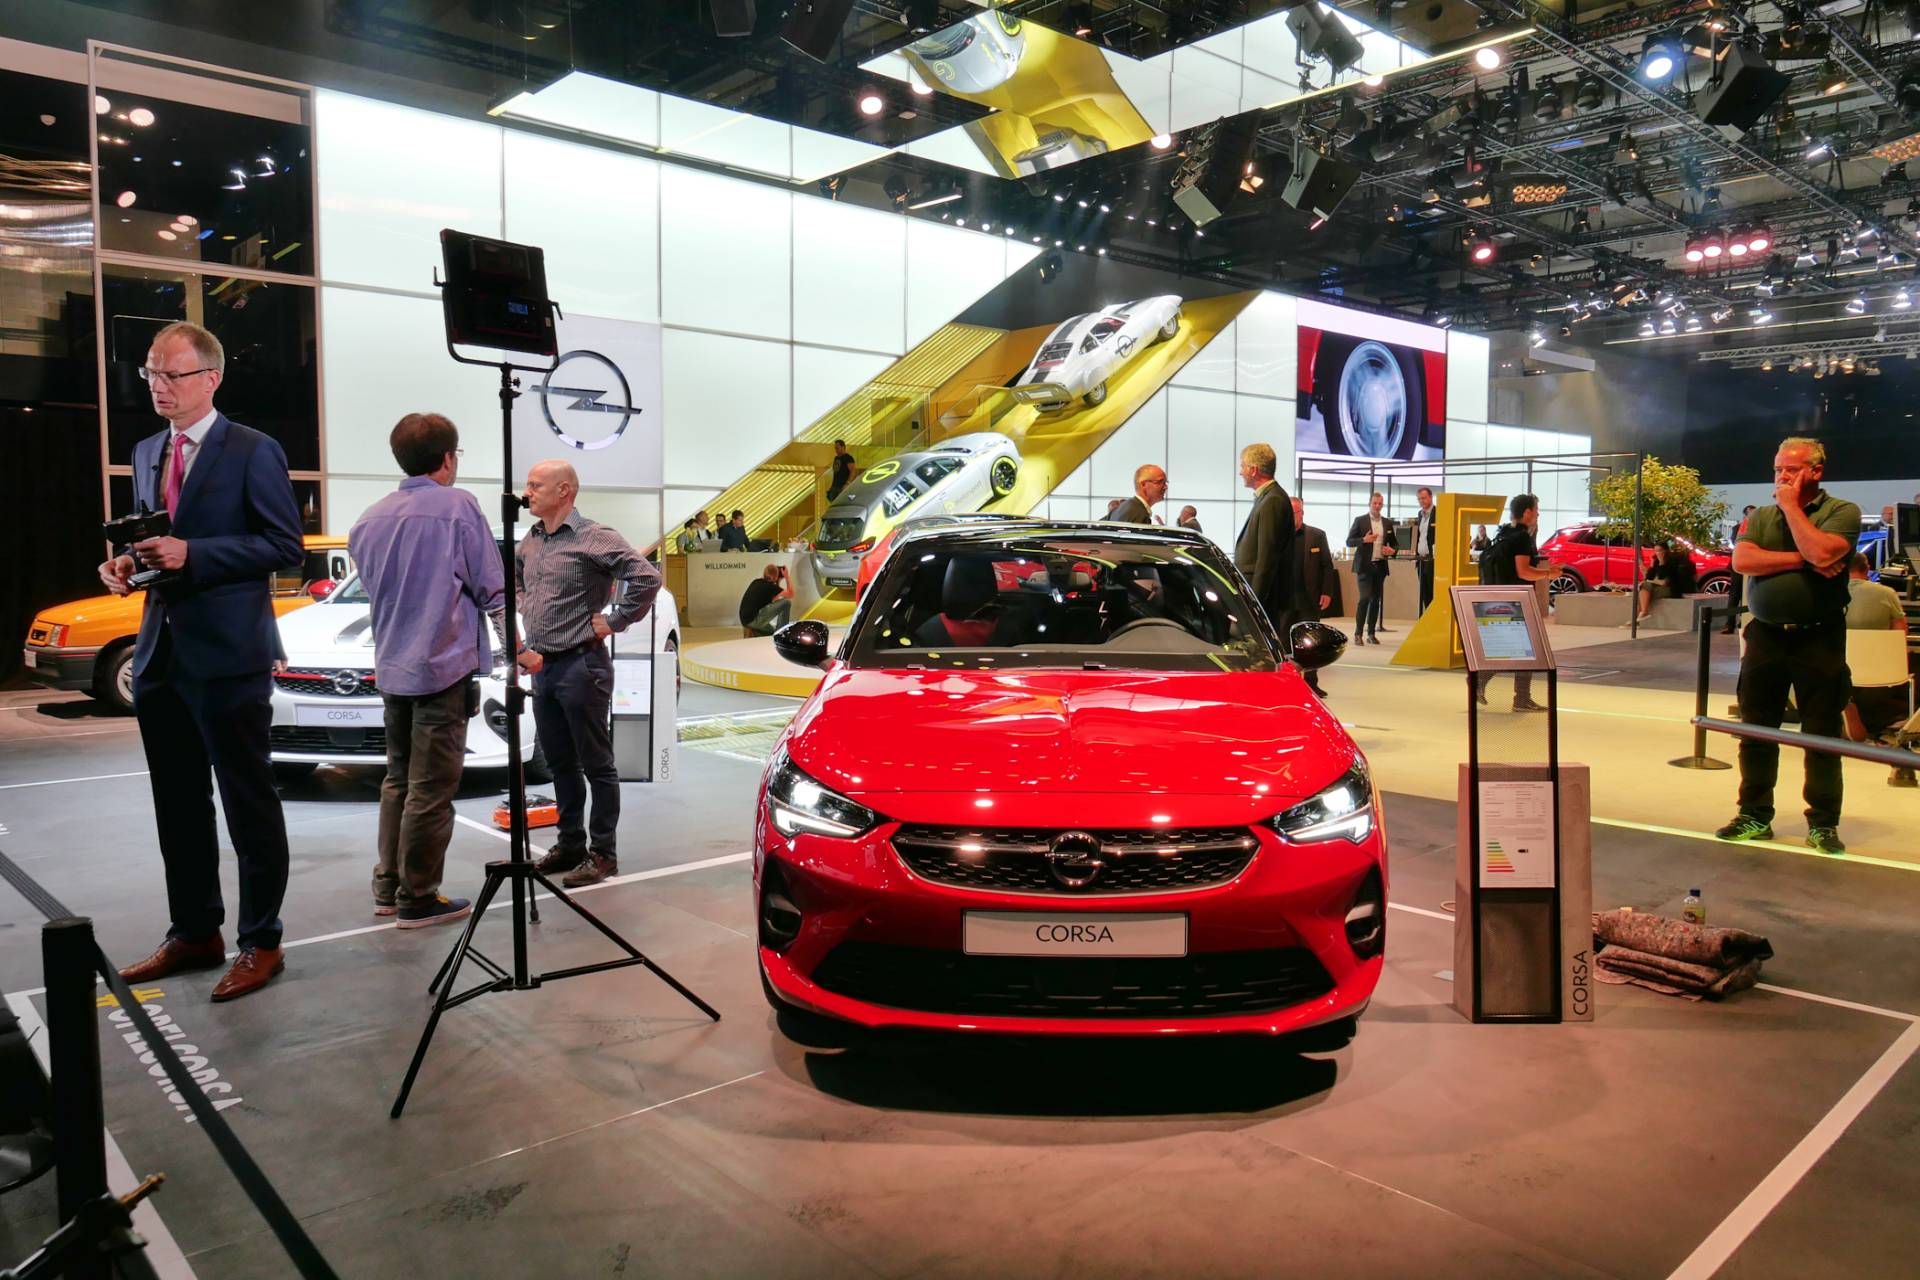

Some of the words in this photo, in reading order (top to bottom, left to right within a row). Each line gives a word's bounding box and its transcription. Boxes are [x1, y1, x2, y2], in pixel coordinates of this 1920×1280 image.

[704, 562, 747, 570] WILLKOMMEN
[327, 711, 362, 720] CORSA
[660, 747, 670, 780] CORSA
[1036, 924, 1114, 943] CORSA
[1572, 950, 1589, 1015] CORSA
